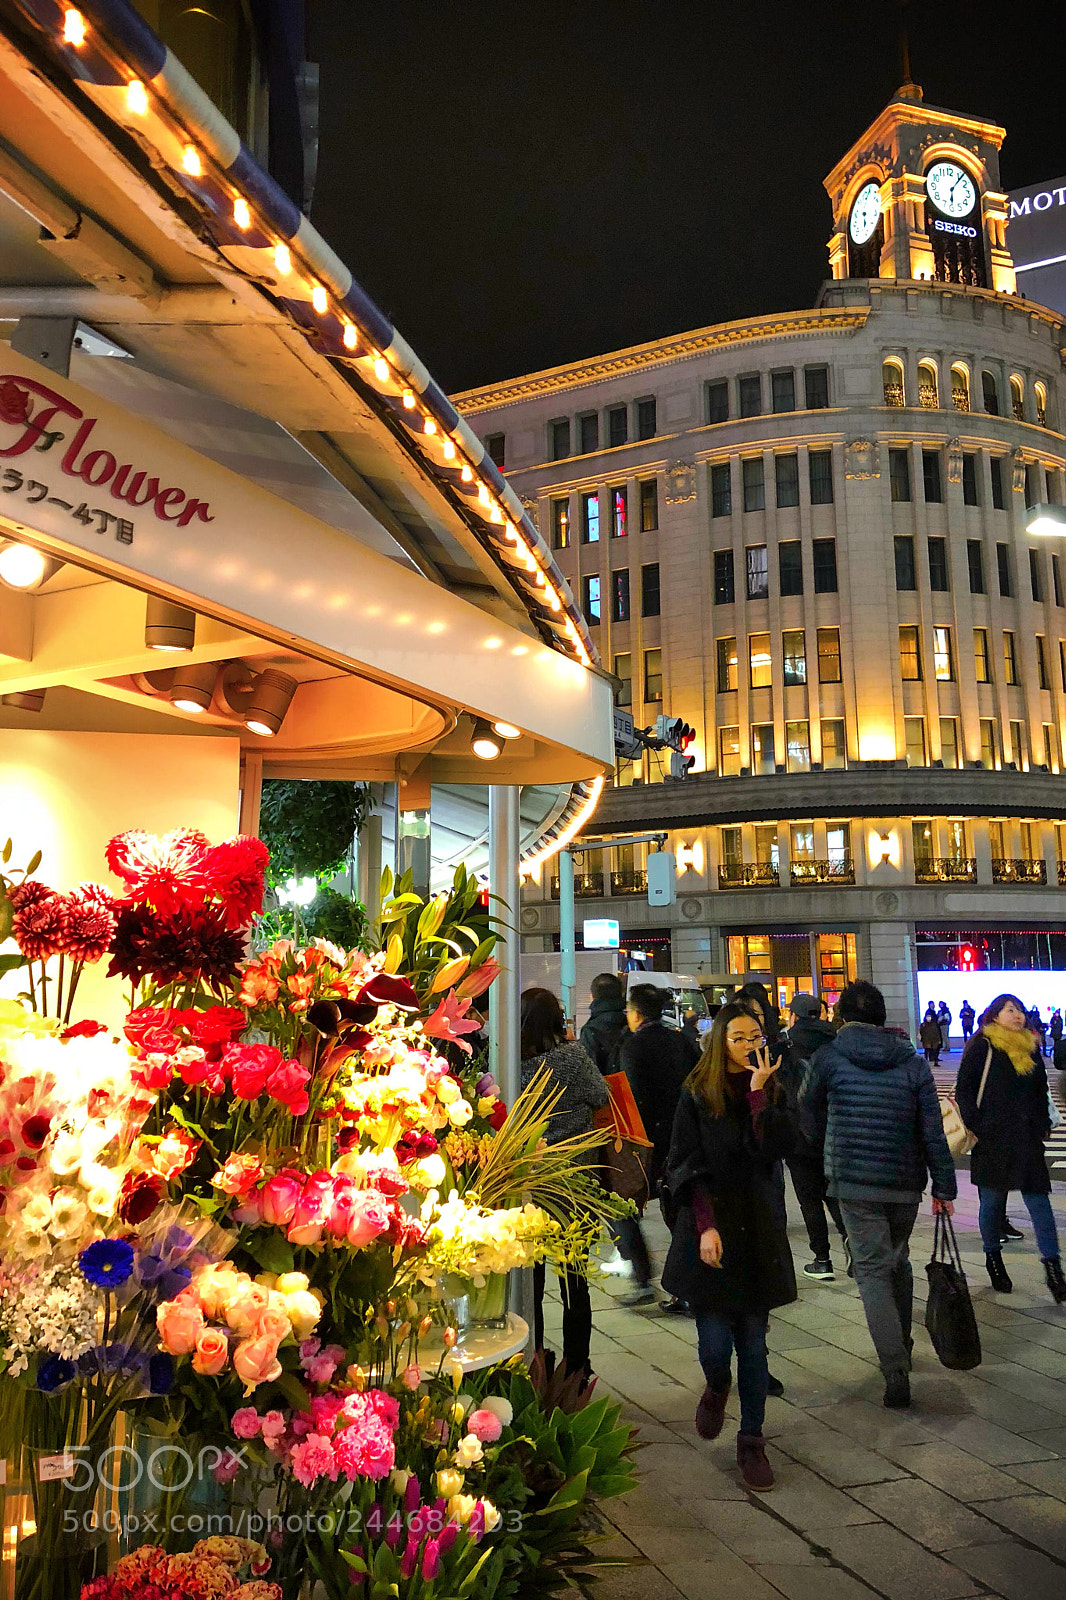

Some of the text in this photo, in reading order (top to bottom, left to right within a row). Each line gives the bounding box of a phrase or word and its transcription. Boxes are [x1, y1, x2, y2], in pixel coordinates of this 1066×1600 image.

[1009, 186, 1066, 219] MOT
[934, 219, 977, 238] SEIKO
[0, 374, 215, 527] Flower
